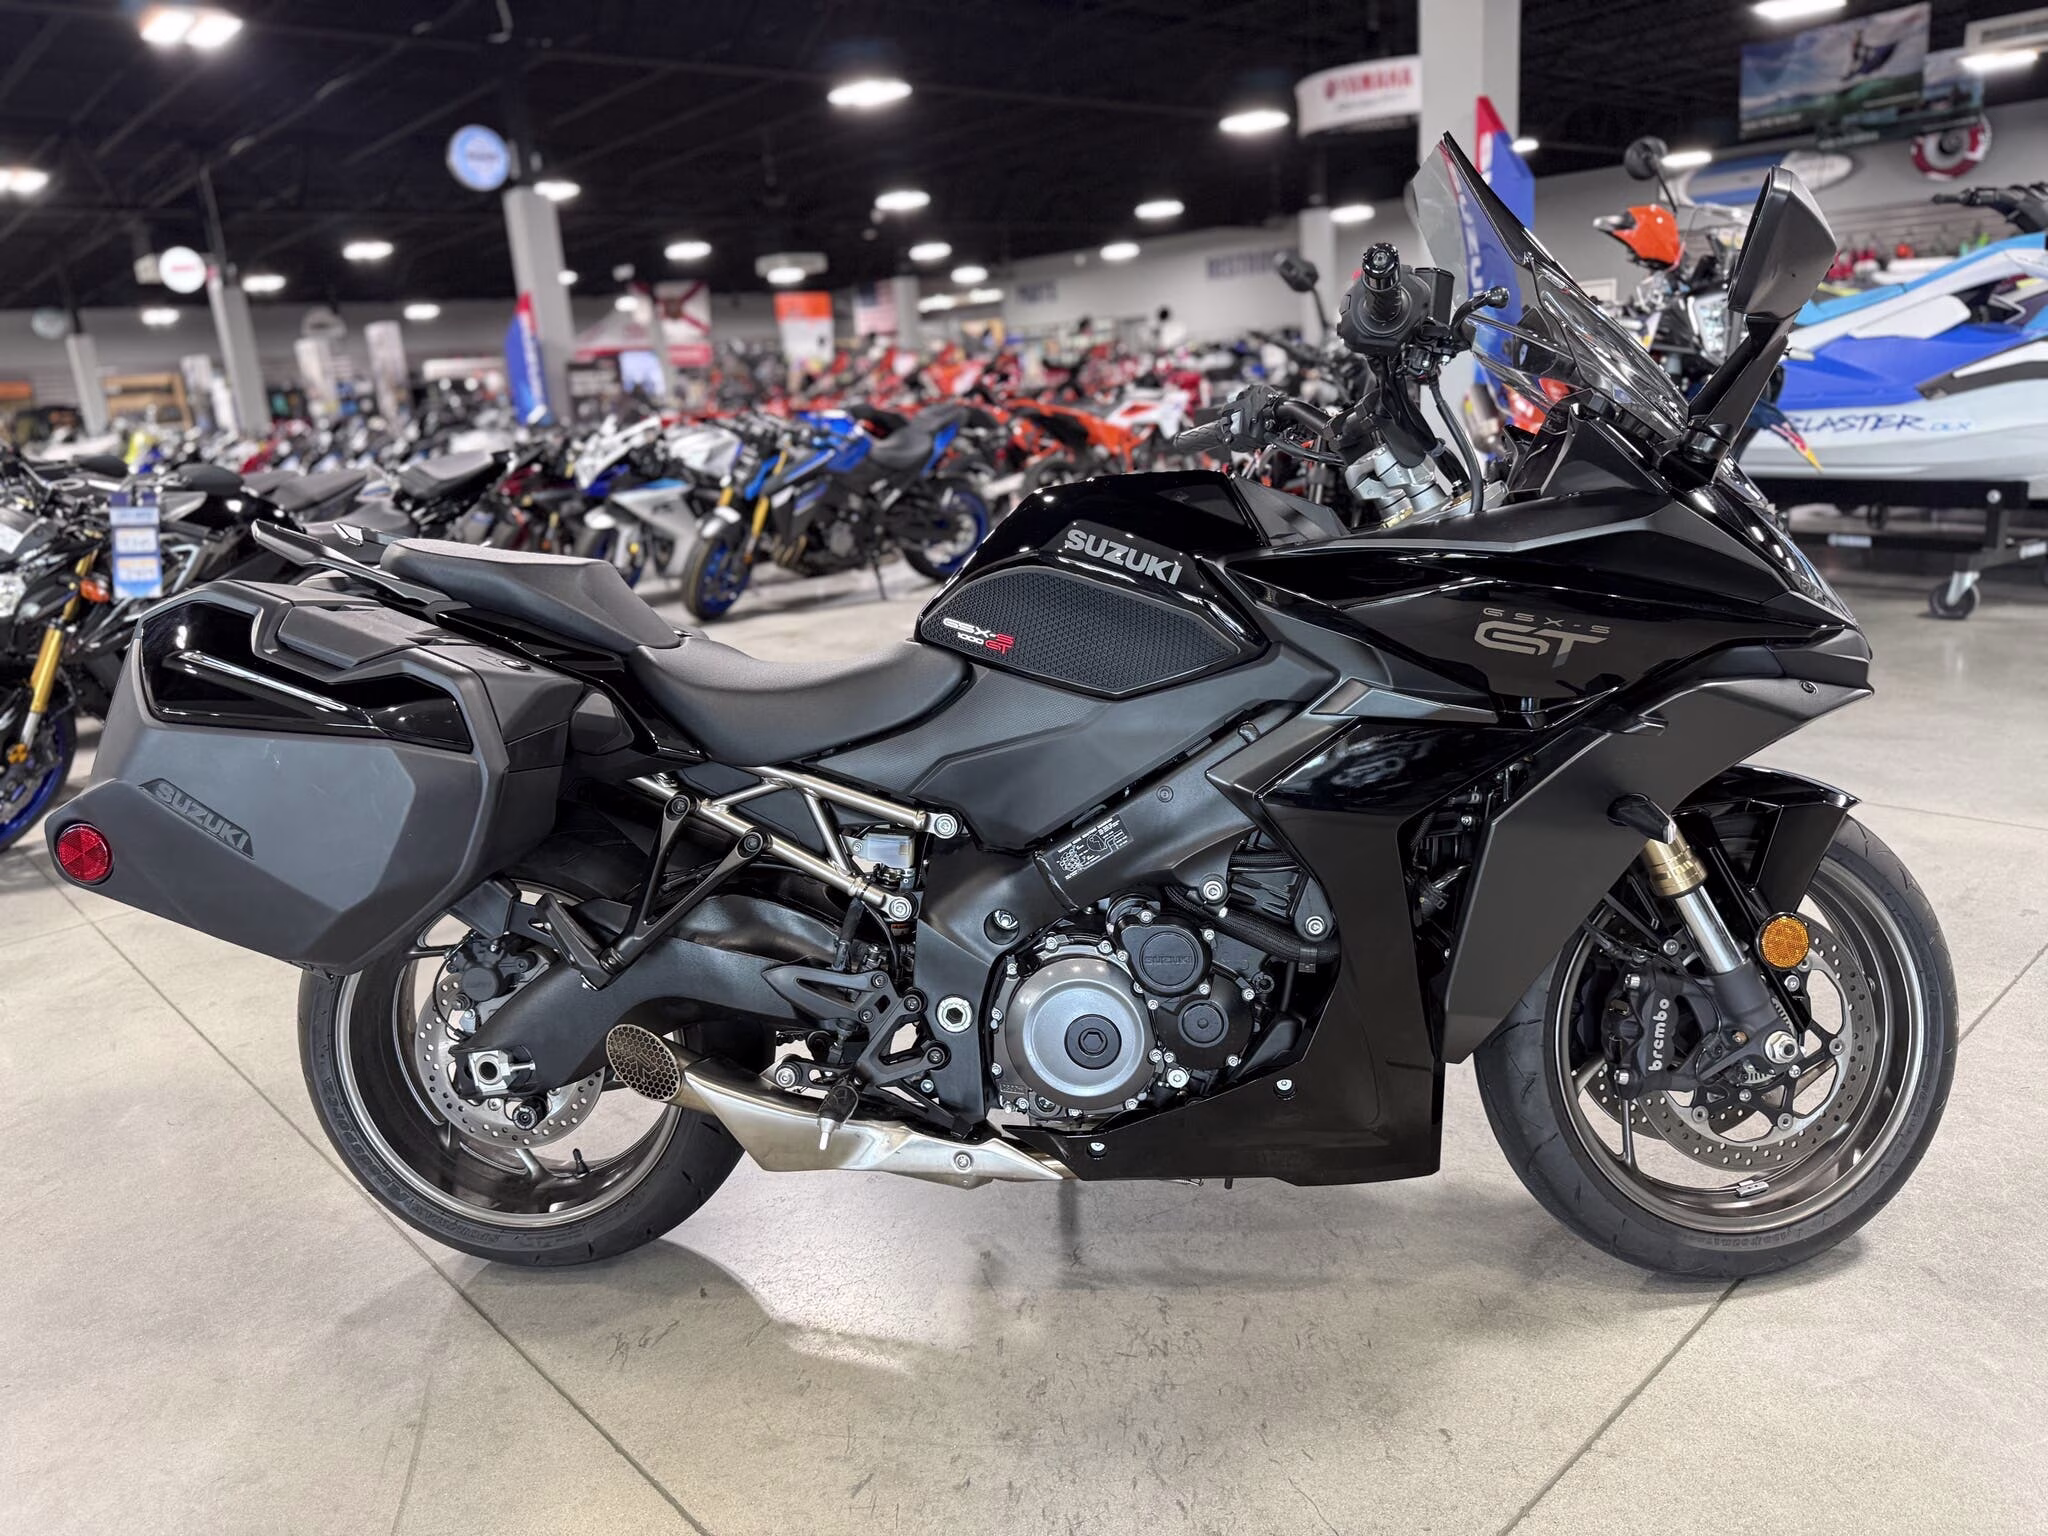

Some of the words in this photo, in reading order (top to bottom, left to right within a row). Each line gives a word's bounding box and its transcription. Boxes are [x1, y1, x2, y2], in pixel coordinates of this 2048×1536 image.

[1064, 529, 1183, 585] SUZUKI
[943, 618, 1015, 645] GSX-S
[1482, 607, 1611, 635] GSX-S
[957, 632, 984, 645] 1000
[985, 639, 1013, 655] GT
[1474, 620, 1609, 669] GT
[155, 782, 249, 850] SUZUKI
[1144, 955, 1193, 966] SUZUKI
[1648, 998, 1670, 1071] brembo
